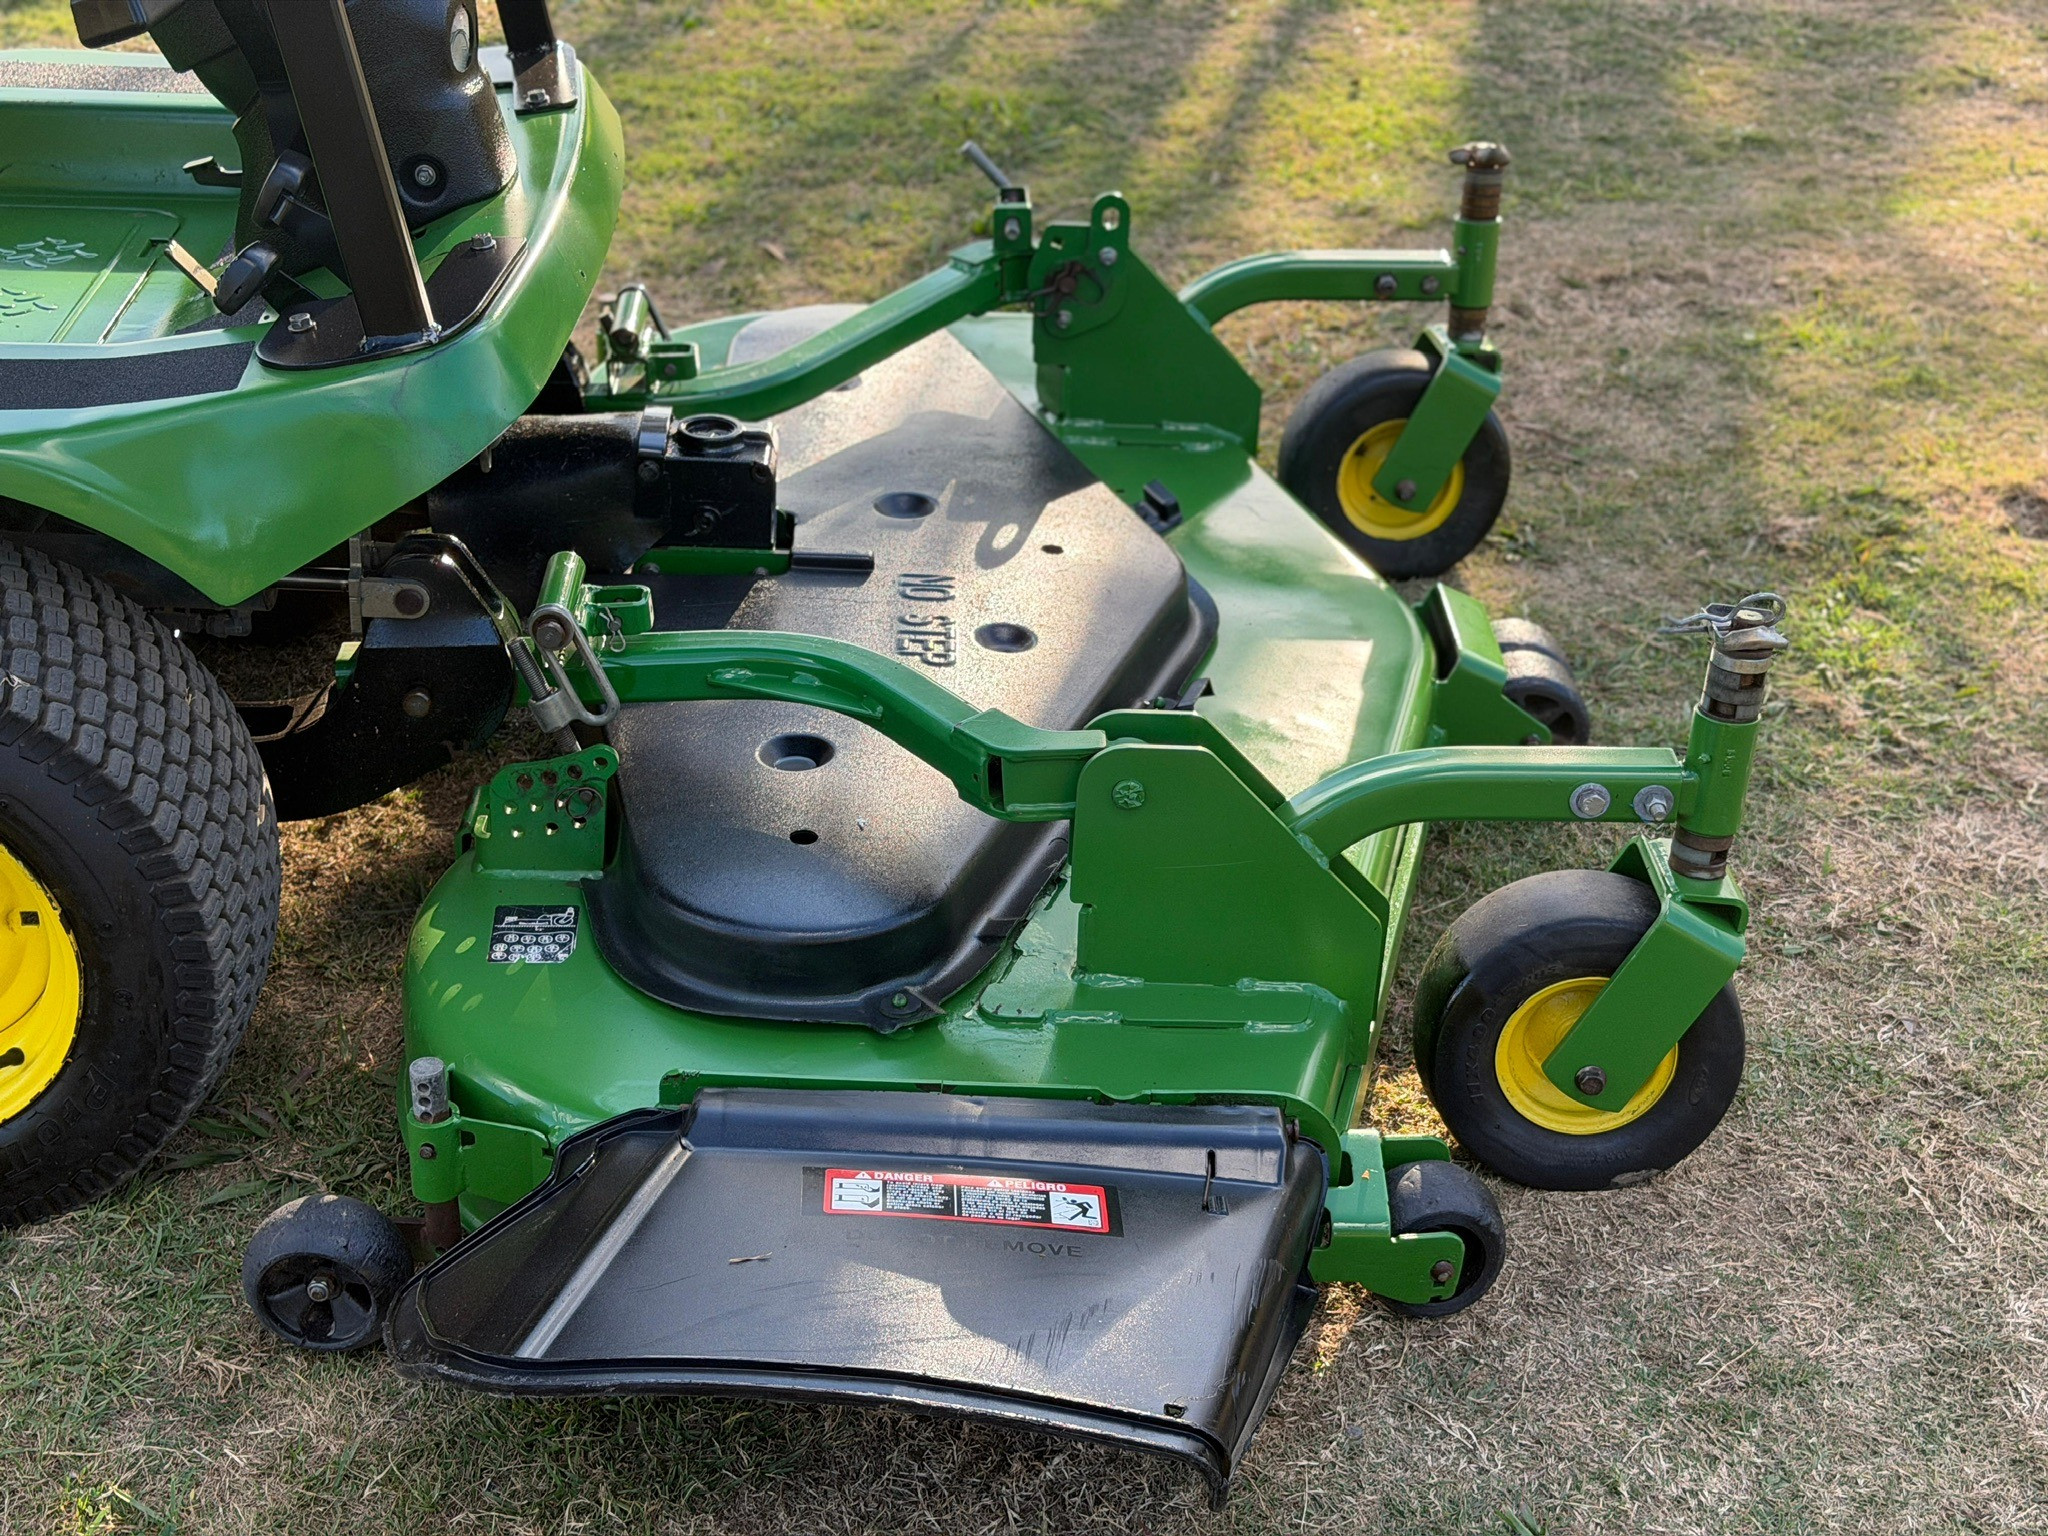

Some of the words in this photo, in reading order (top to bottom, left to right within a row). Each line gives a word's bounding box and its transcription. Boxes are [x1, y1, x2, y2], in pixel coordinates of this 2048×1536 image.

[898, 573, 956, 602] NO
[896, 614, 957, 667] STEP
[874, 1172, 933, 1182] DANGER
[1005, 1180, 1067, 1192] PELIGRO
